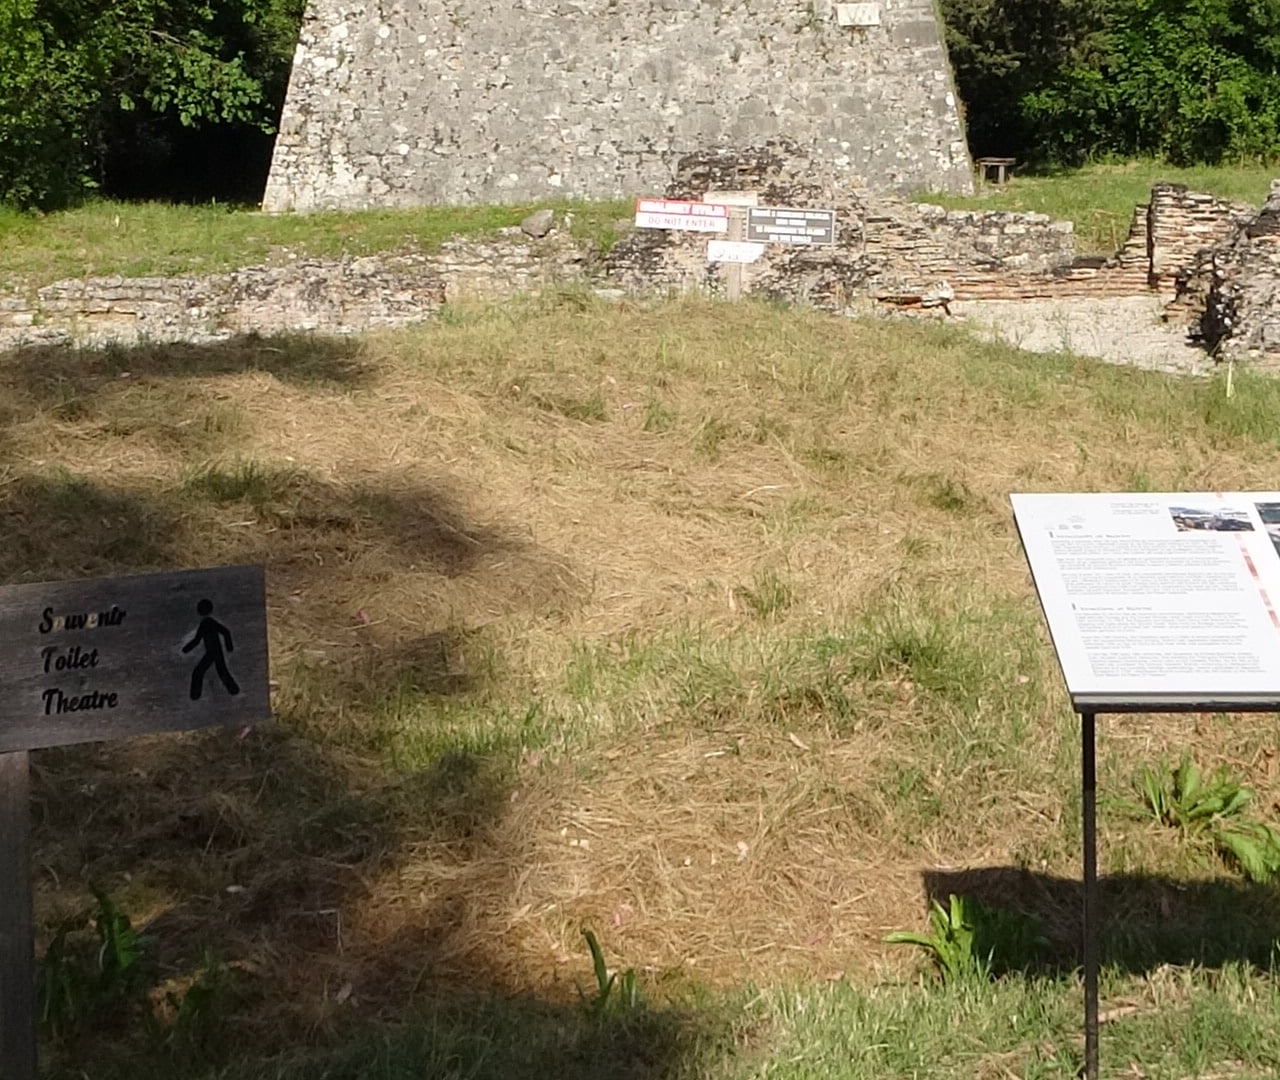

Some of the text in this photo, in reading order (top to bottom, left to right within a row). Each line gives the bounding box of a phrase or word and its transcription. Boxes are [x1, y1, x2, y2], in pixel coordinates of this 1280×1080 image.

[664, 217, 681, 226] NOT
[39, 606, 127, 634] Souvenir
[41, 646, 100, 674] Toilet
[42, 688, 119, 715] Theatre
